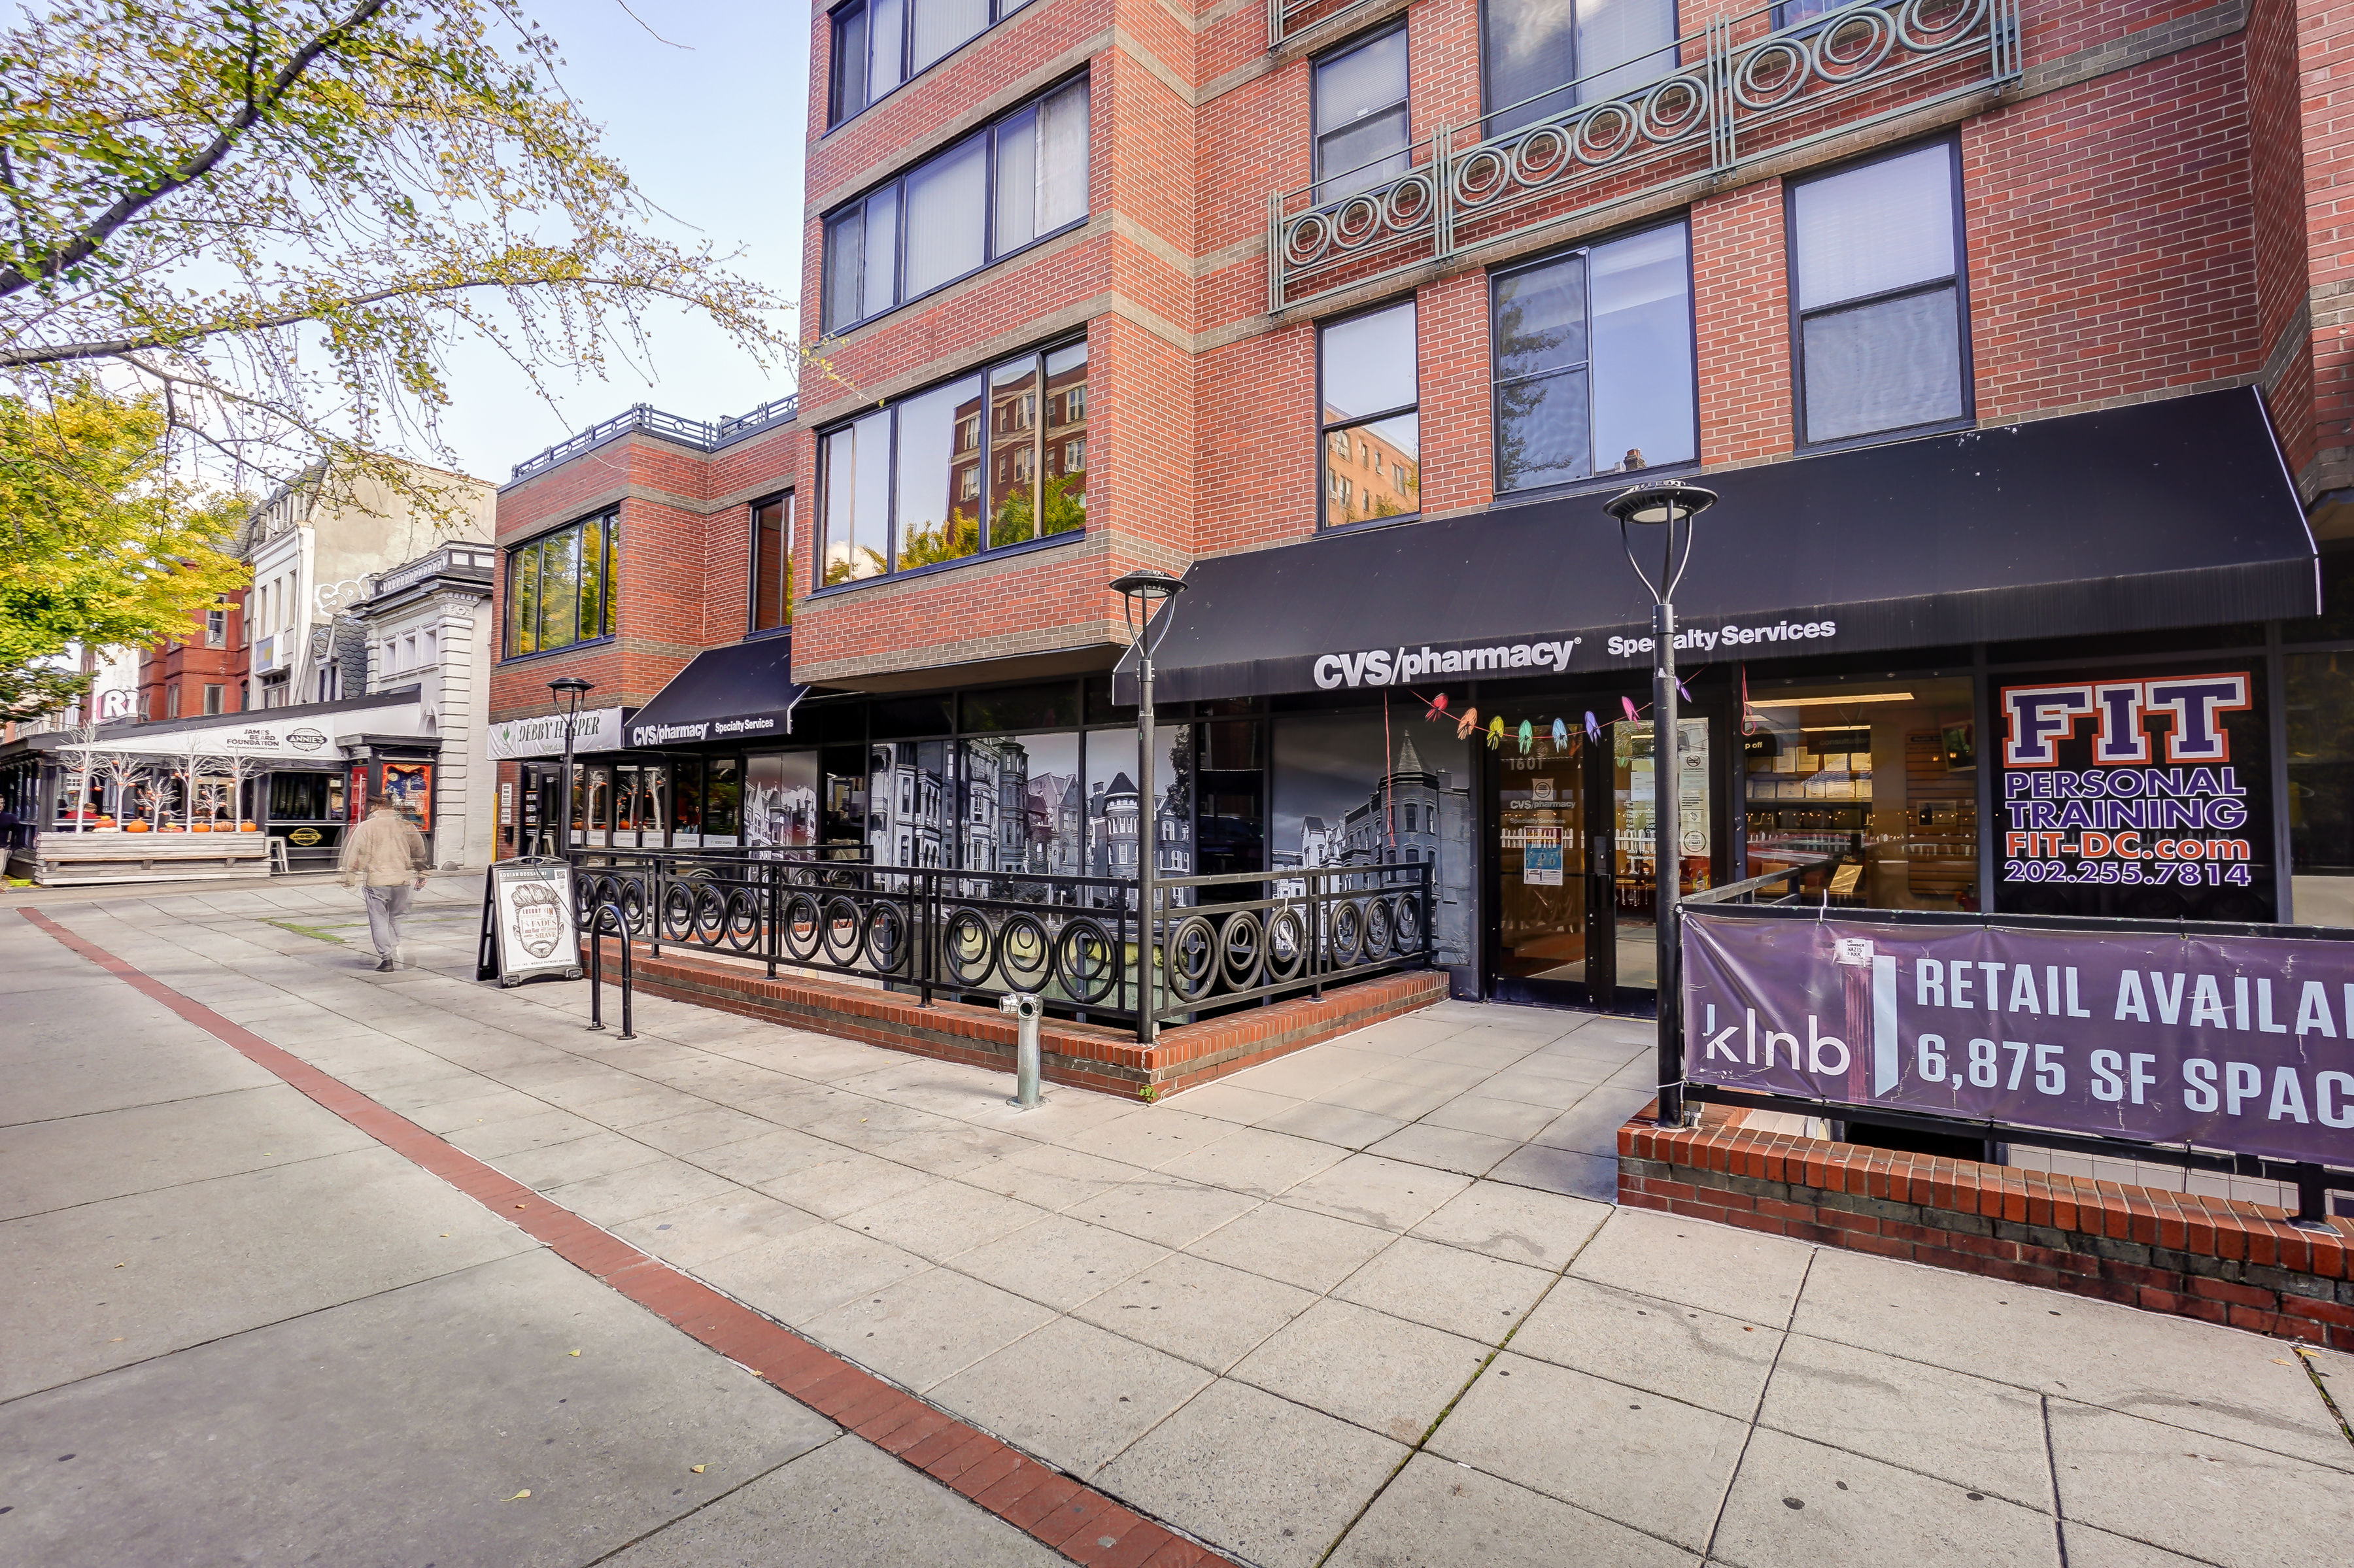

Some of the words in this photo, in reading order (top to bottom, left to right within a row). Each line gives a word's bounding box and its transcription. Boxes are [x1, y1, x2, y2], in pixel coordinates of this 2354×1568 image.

[1607, 628, 1719, 658] Spealty
[1721, 621, 1836, 646] Services
[519, 722, 553, 742] DEBBY
[554, 716, 600, 739] HRPER
[715, 721, 745, 734] Specialty
[744, 718, 774, 730] Services
[2001, 672, 2252, 768] FIT
[1819, 737, 1869, 745] consultation
[1510, 757, 1543, 770] 1601
[2005, 767, 2246, 798] PERSONAL
[1510, 800, 1576, 810] CVS/pharmacy
[2005, 798, 2247, 829] TRAINING
[2006, 830, 2251, 860] FIT-DC.com
[2004, 860, 2251, 886] 202.255.7814
[1916, 958, 2091, 1018] RETAIL
[1706, 1003, 1851, 1076] klnb
[1917, 1033, 2066, 1097] 6,875
[2090, 1049, 2157, 1105] SF
[2183, 1058, 2354, 1129] SPAC
